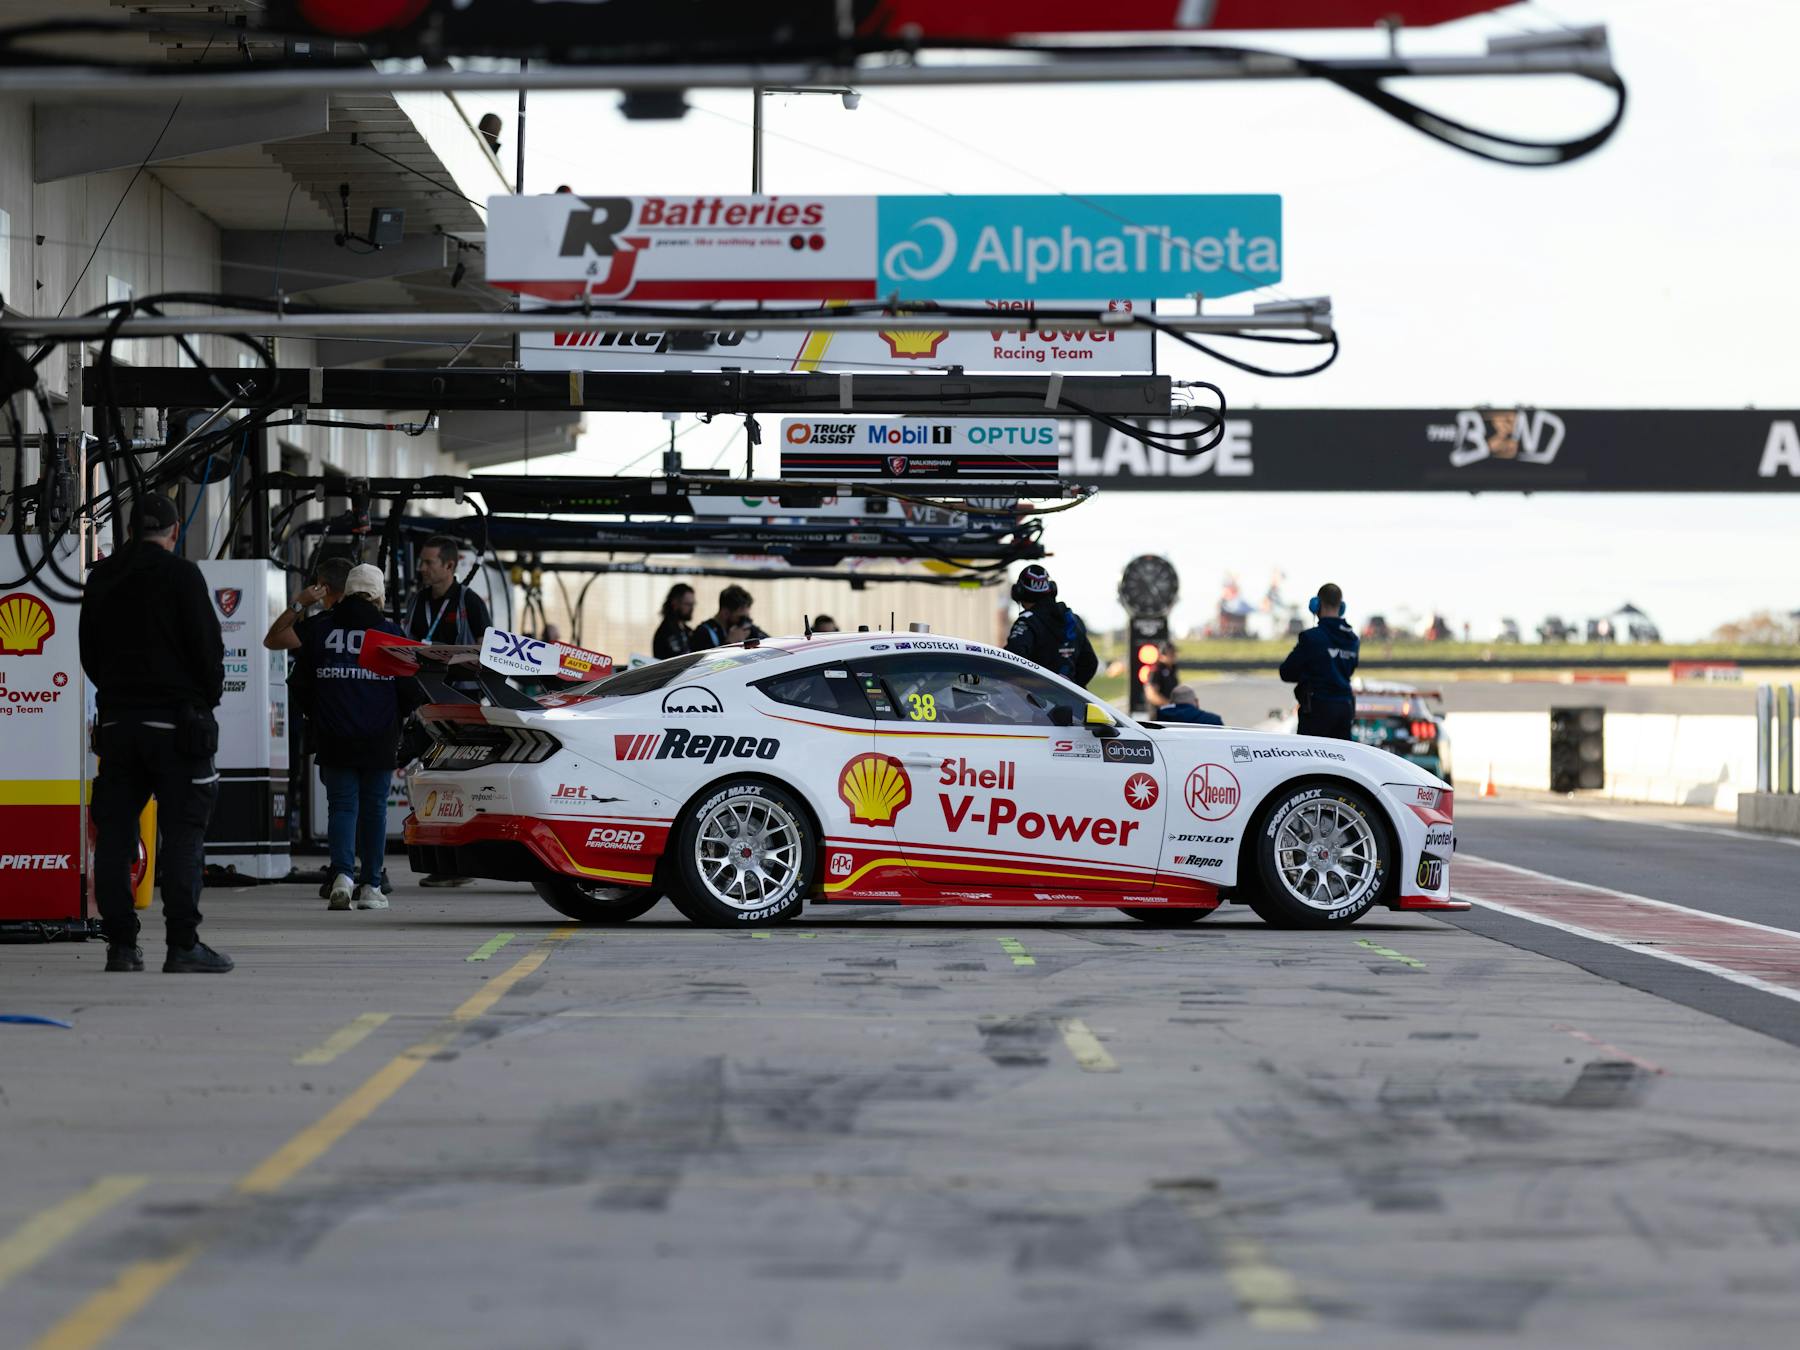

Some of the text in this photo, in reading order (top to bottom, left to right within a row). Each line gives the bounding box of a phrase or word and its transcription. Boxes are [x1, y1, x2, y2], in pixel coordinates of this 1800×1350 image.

[638, 197, 824, 227] Batteries
[968, 225, 1280, 284] AlphaTheta
[993, 346, 1094, 362] Racing Team
[814, 424, 857, 434] TRUCK
[868, 425, 928, 444] Mobil
[967, 426, 1054, 444] OPTUS
[809, 434, 855, 444] ASSIST
[490, 630, 546, 665] DXC
[913, 641, 959, 650] KOSTECKI
[489, 655, 541, 675] TECHNOLOGY
[567, 660, 589, 670] AUTO
[983, 647, 1040, 670] HAZELWOOD
[224, 664, 248, 673] TUS
[316, 667, 396, 681] SCRUTIN
[16, 705, 44, 714] Team
[667, 704, 718, 713] MAN
[908, 693, 937, 721] 38
[655, 728, 781, 764] Repco
[1108, 745, 1152, 758] airtouch
[1253, 747, 1347, 763] national tiles
[938, 757, 1015, 790] Shell
[551, 783, 589, 798] Jet
[1191, 765, 1237, 811] Rheem
[437, 797, 464, 817] HELIX
[696, 785, 764, 822] SPORT MAXX
[938, 793, 1140, 847] V-Power
[1266, 788, 1322, 838] SPORT MAXX
[587, 828, 646, 844] FORD
[1178, 834, 1235, 845] DUNLOP
[585, 840, 643, 851] PERFORMANCE
[0, 854, 71, 870] PIRTEK
[831, 855, 852, 873] PPG
[1185, 855, 1224, 868] Repco
[1418, 859, 1441, 887] OTR
[737, 888, 799, 921] DUNLOP
[1328, 878, 1381, 920] DUNLOP
